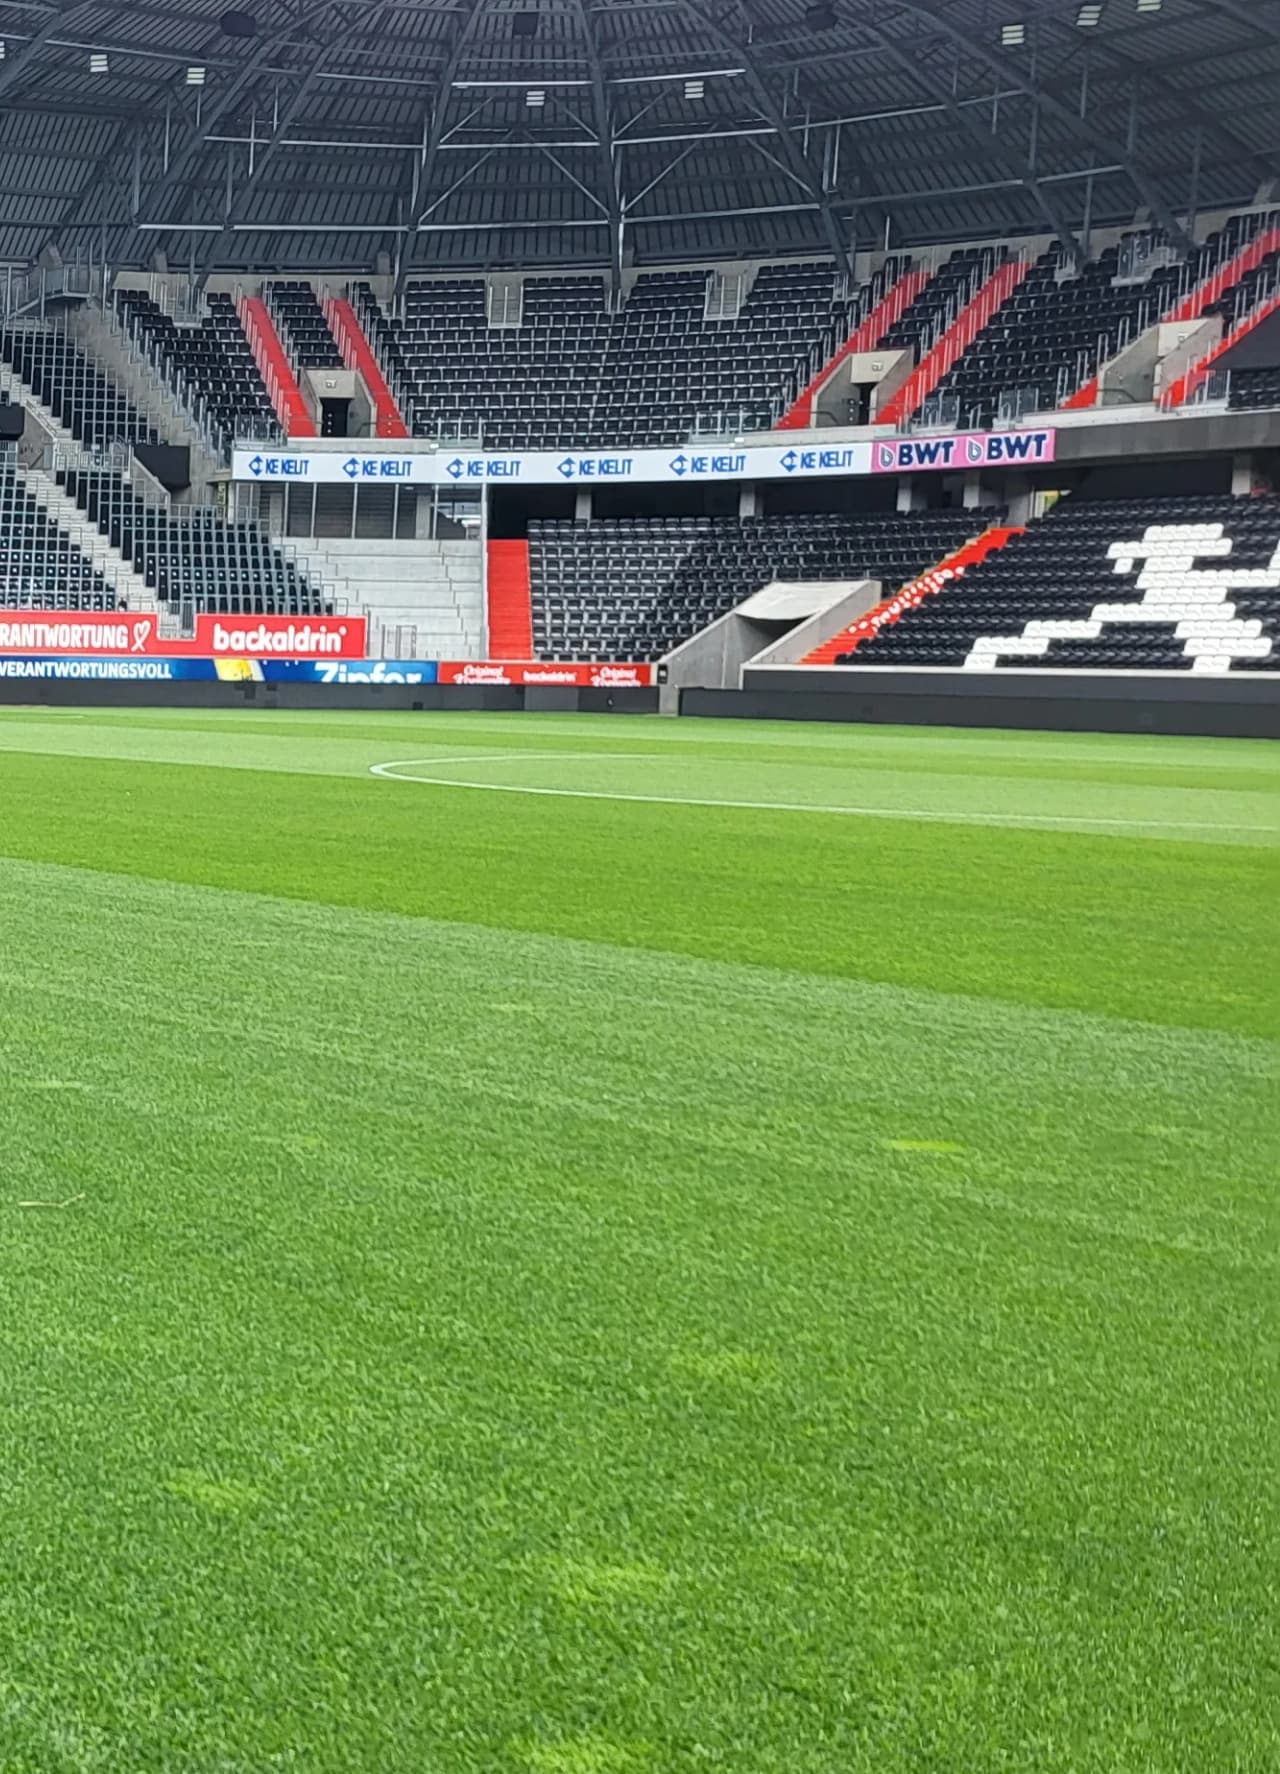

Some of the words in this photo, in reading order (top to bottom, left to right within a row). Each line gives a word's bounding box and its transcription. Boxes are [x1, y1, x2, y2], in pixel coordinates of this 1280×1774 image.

[898, 441, 954, 466] BWT
[987, 434, 1046, 460] BWT
[265, 459, 278, 475] KE
[281, 459, 309, 475] KELIT
[362, 460, 376, 476] KE
[380, 461, 412, 476] KELIT
[467, 461, 483, 476] KE
[487, 461, 520, 477] KELIT
[579, 459, 594, 476] KE
[598, 459, 633, 475] KELIT
[691, 456, 707, 473] KE
[711, 455, 747, 473] KELIT
[800, 452, 815, 469] KE
[819, 451, 853, 468] KELIT
[213, 623, 342, 652] backaldrin
